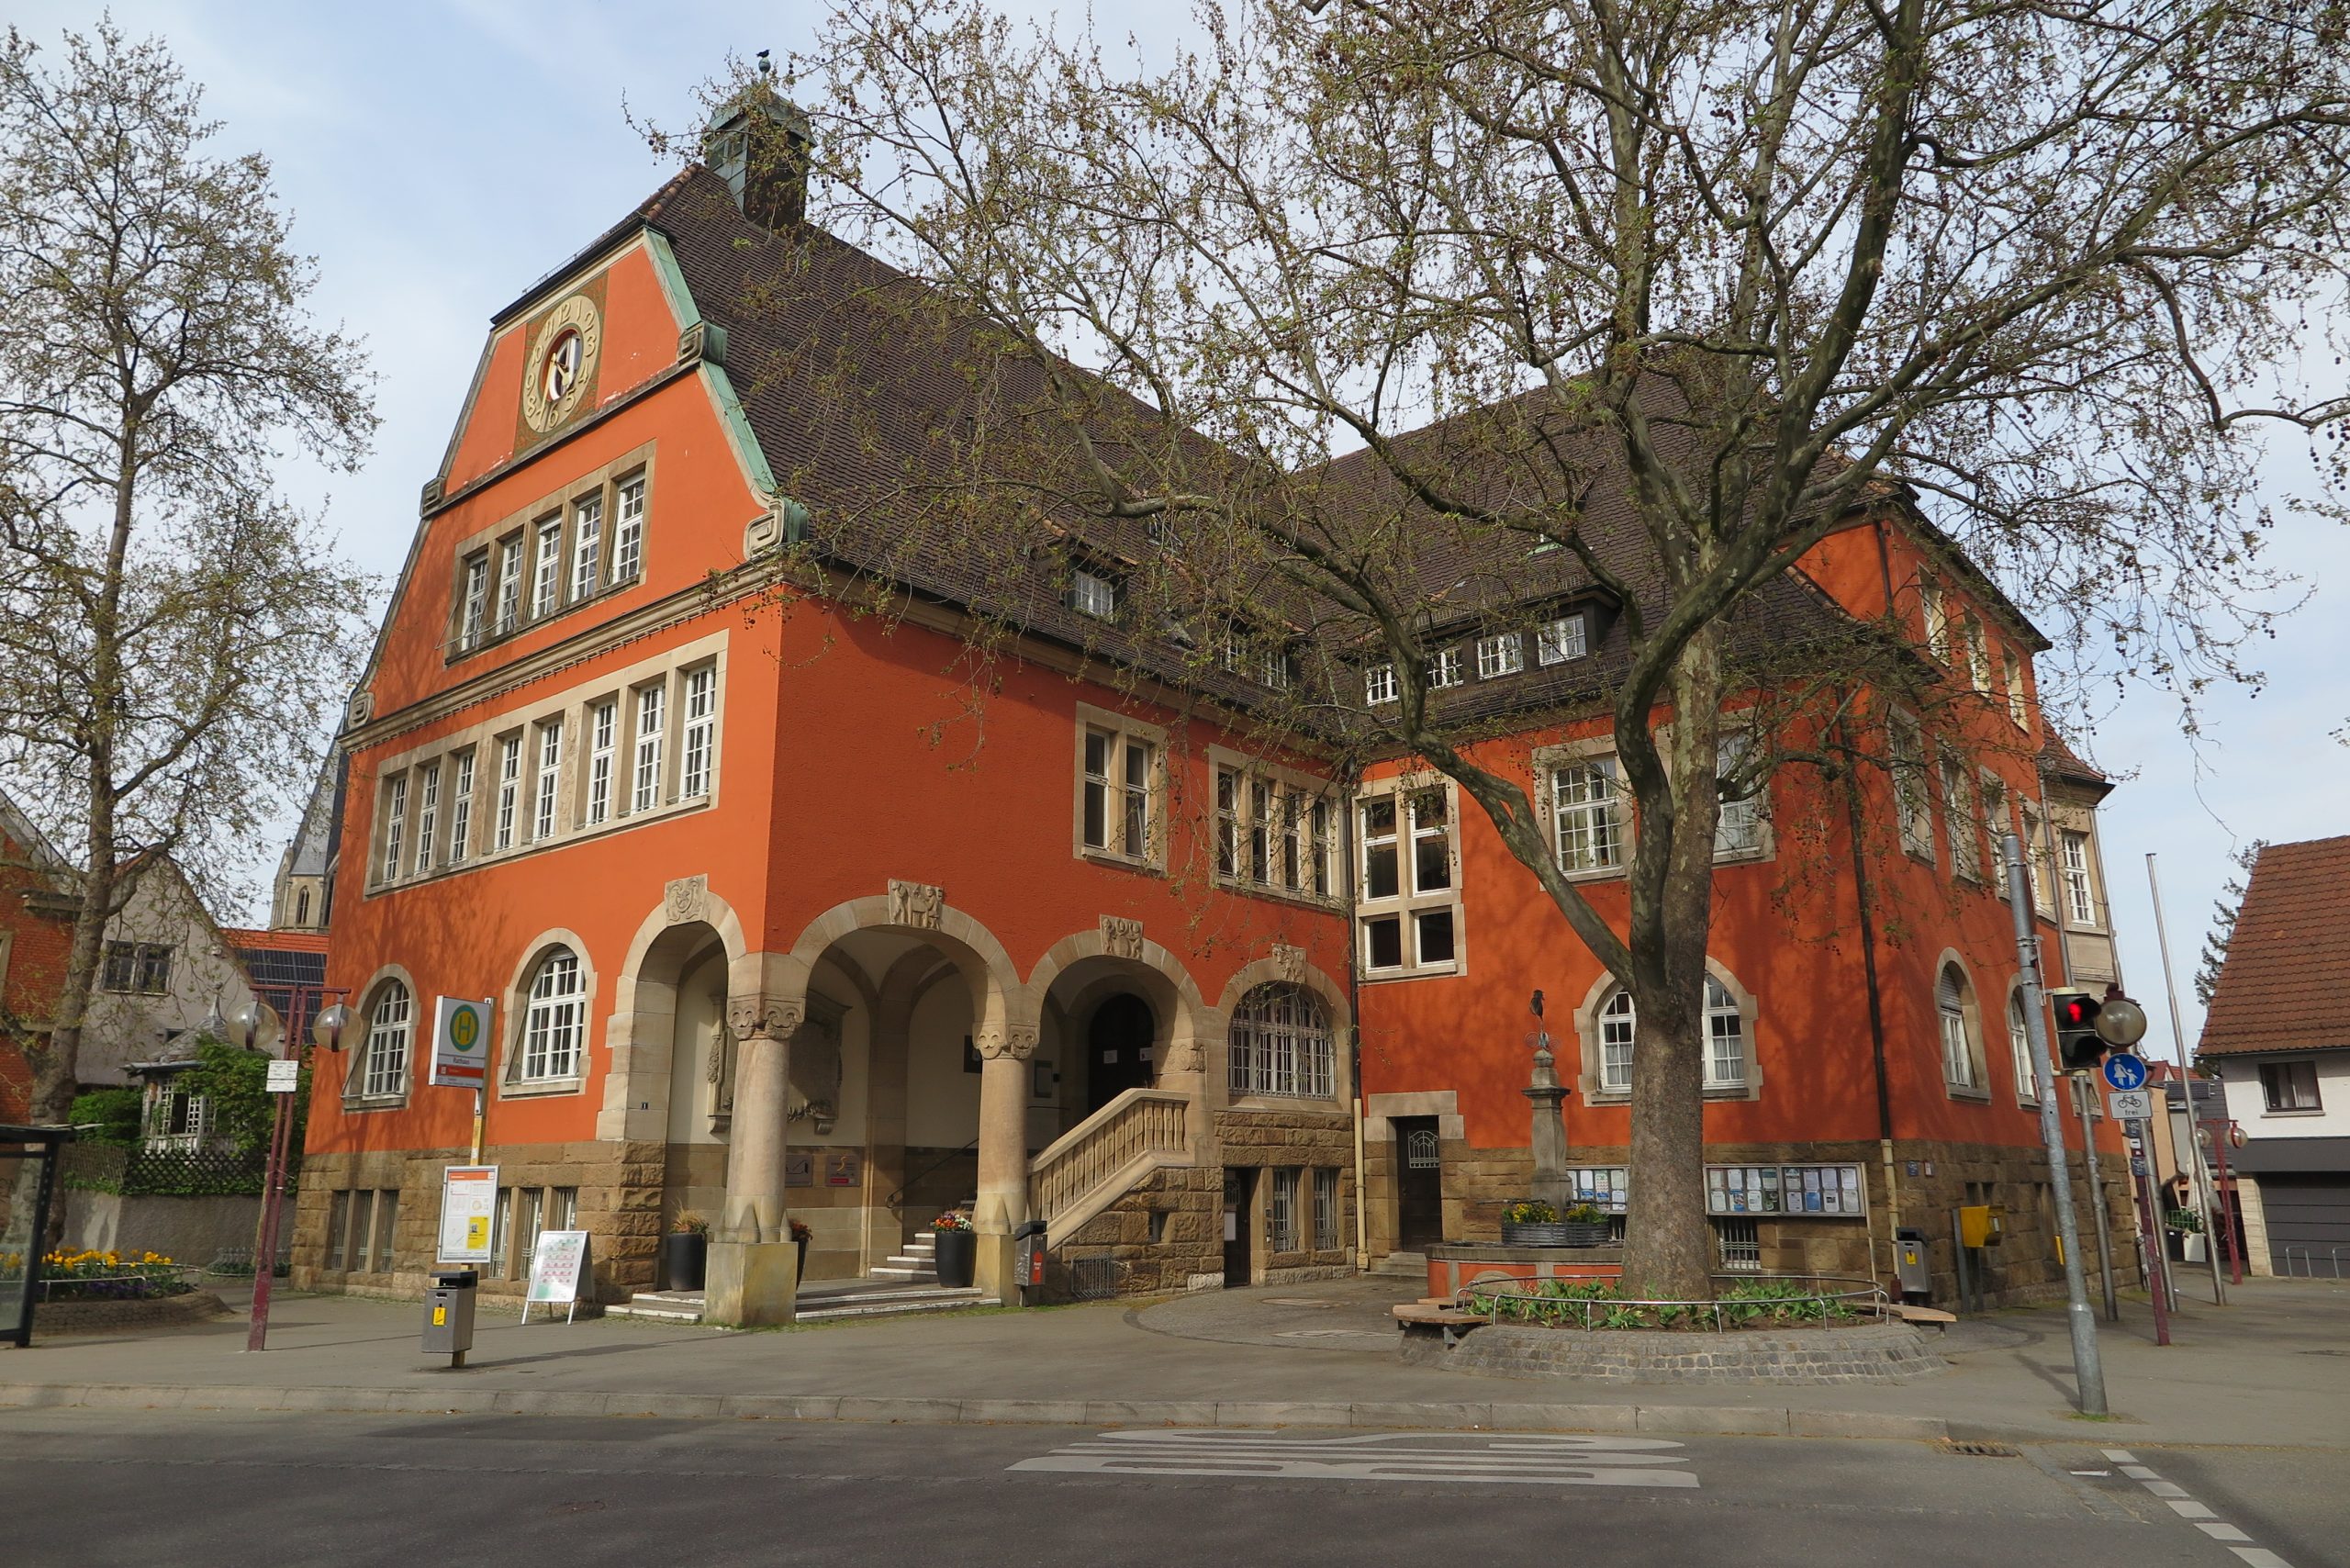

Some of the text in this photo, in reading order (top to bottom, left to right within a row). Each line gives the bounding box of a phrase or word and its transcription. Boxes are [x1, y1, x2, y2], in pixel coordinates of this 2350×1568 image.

[558, 302, 572, 325] 12
[576, 299, 582, 319] 1
[543, 319, 554, 341] 11
[584, 312, 596, 333] 2
[532, 344, 544, 368] 10
[585, 335, 597, 358] 3
[526, 373, 536, 397] 9
[578, 363, 589, 386] 4
[527, 396, 537, 419] 8
[565, 388, 577, 412] 5
[548, 402, 559, 429] 6
[458, 1014, 472, 1041] H
